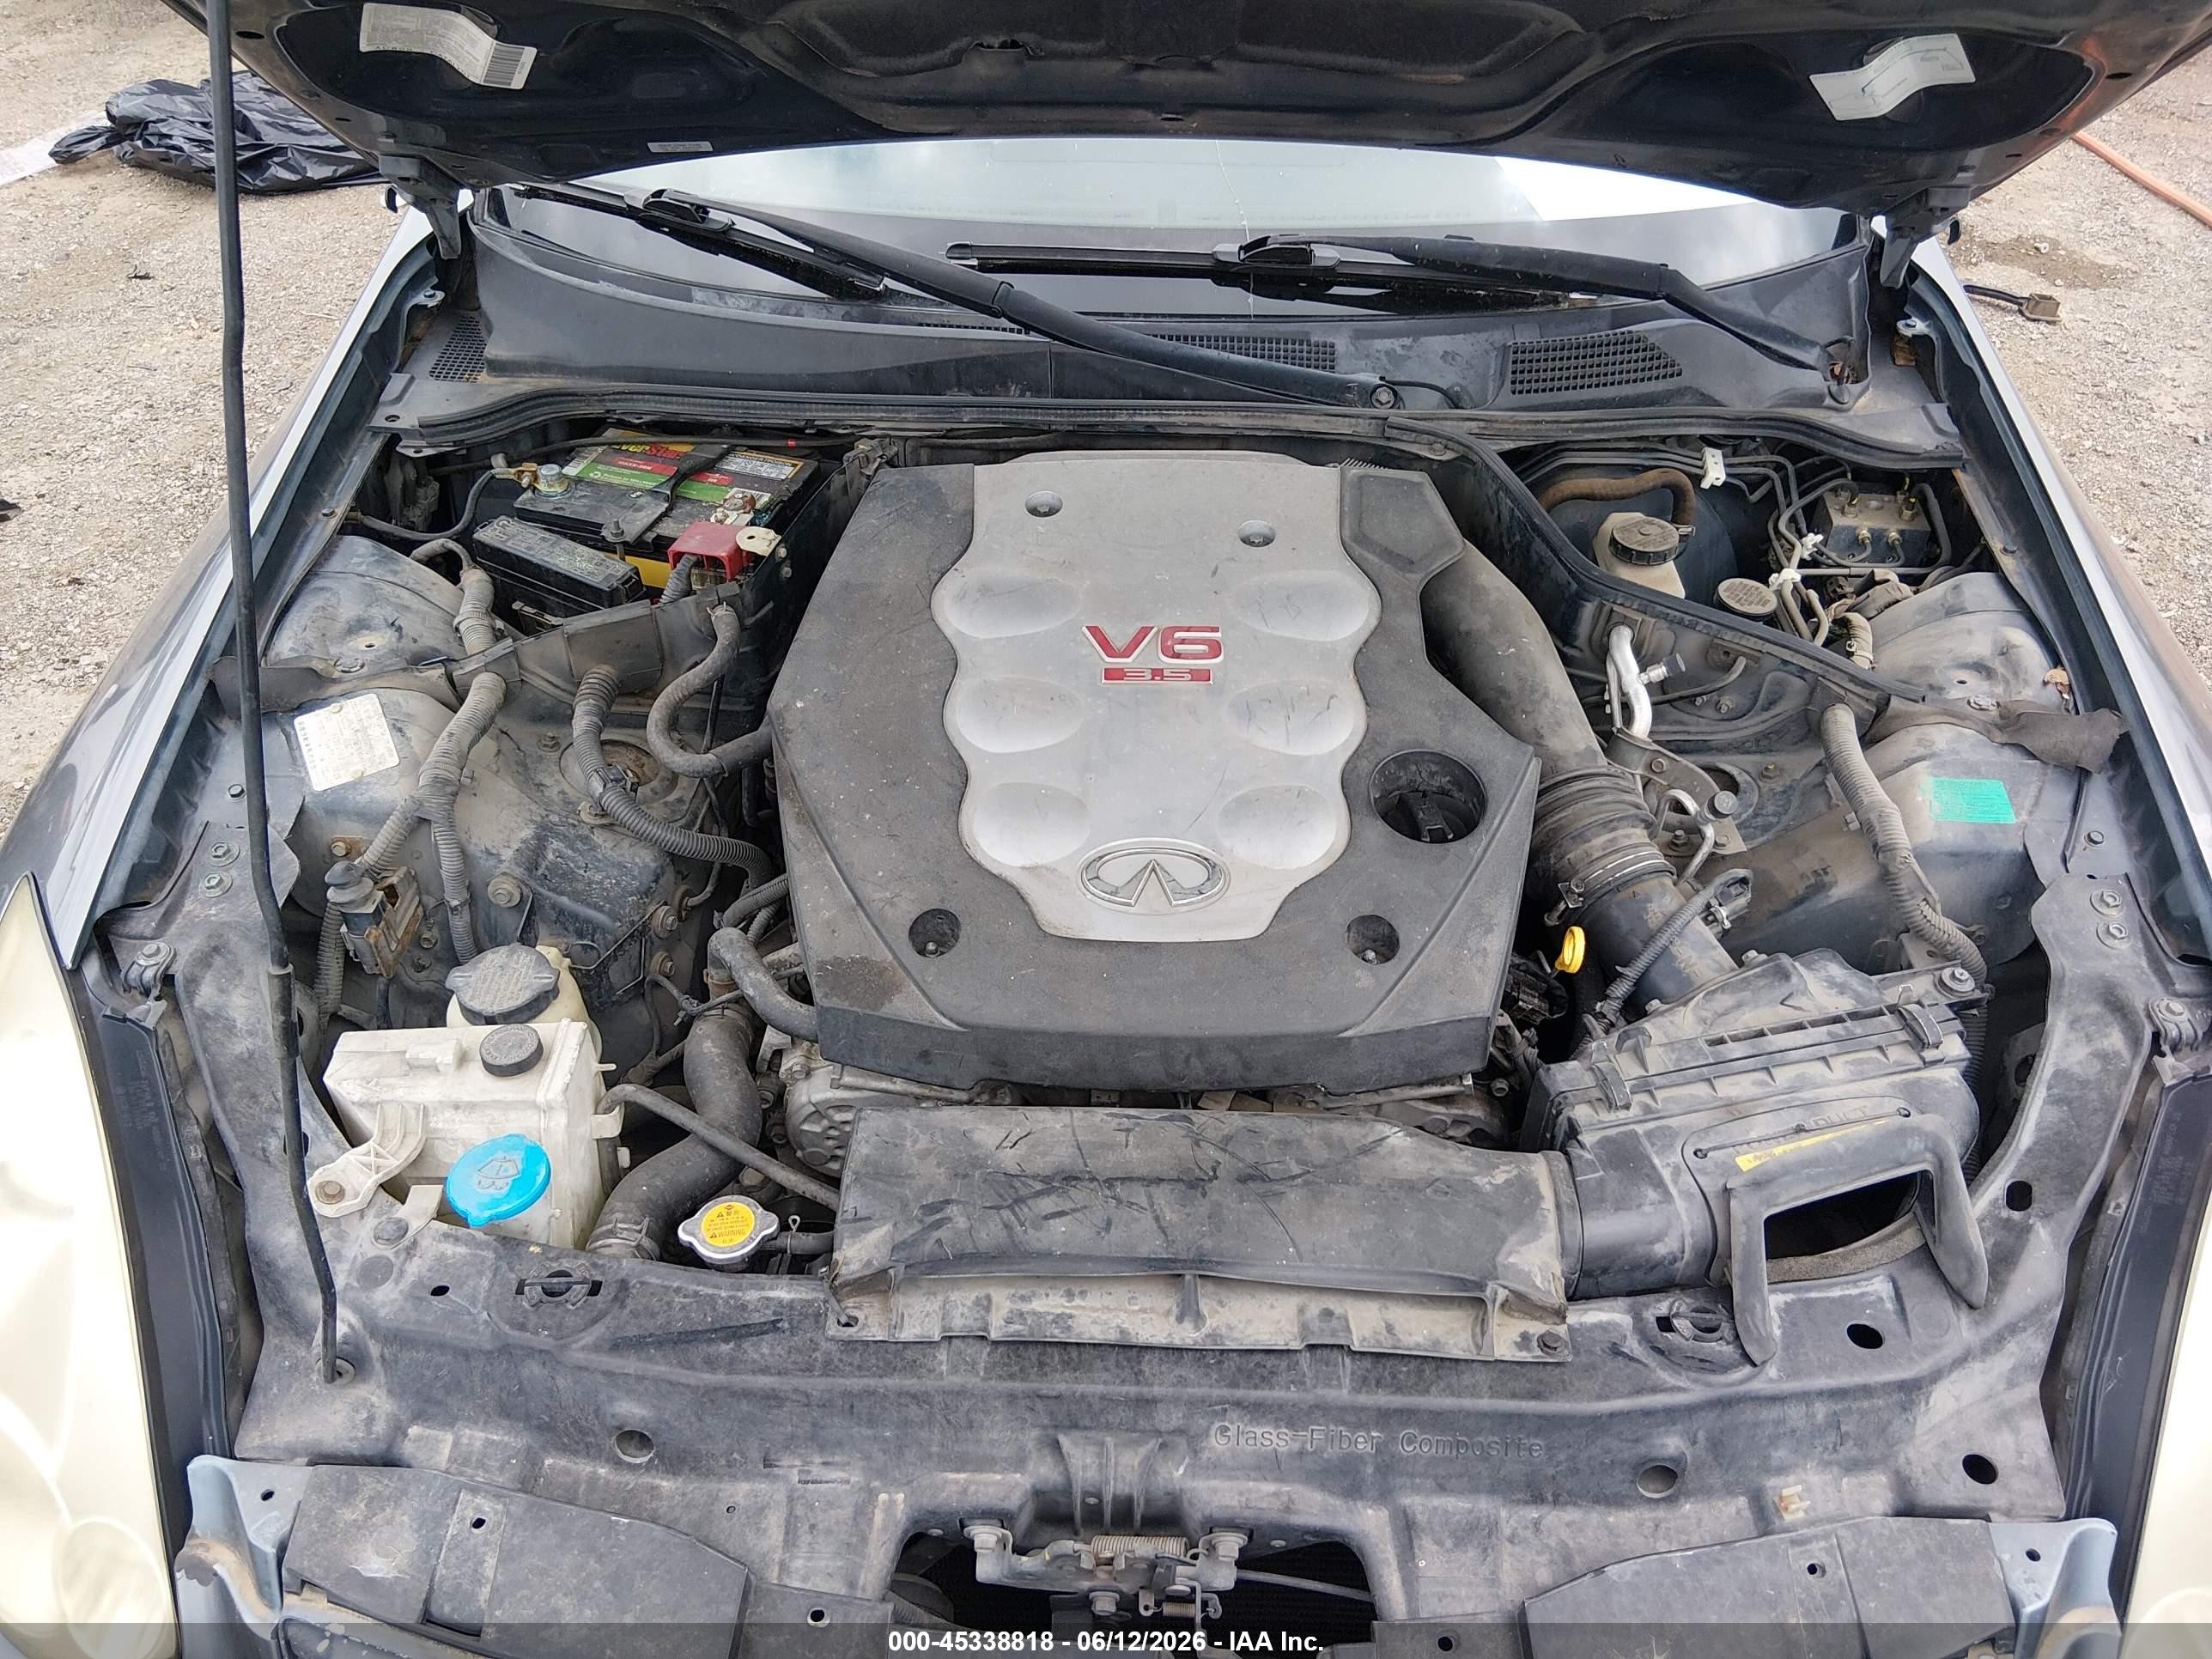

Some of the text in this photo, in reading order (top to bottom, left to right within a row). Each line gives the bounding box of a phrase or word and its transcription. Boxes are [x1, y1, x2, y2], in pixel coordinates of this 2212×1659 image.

[1081, 624, 1224, 665] V6
[1122, 668, 1193, 681] 3.5
[717, 1228, 746, 1238] WARNING
[1213, 1423, 1544, 1460] Glass-Fiber Composite
